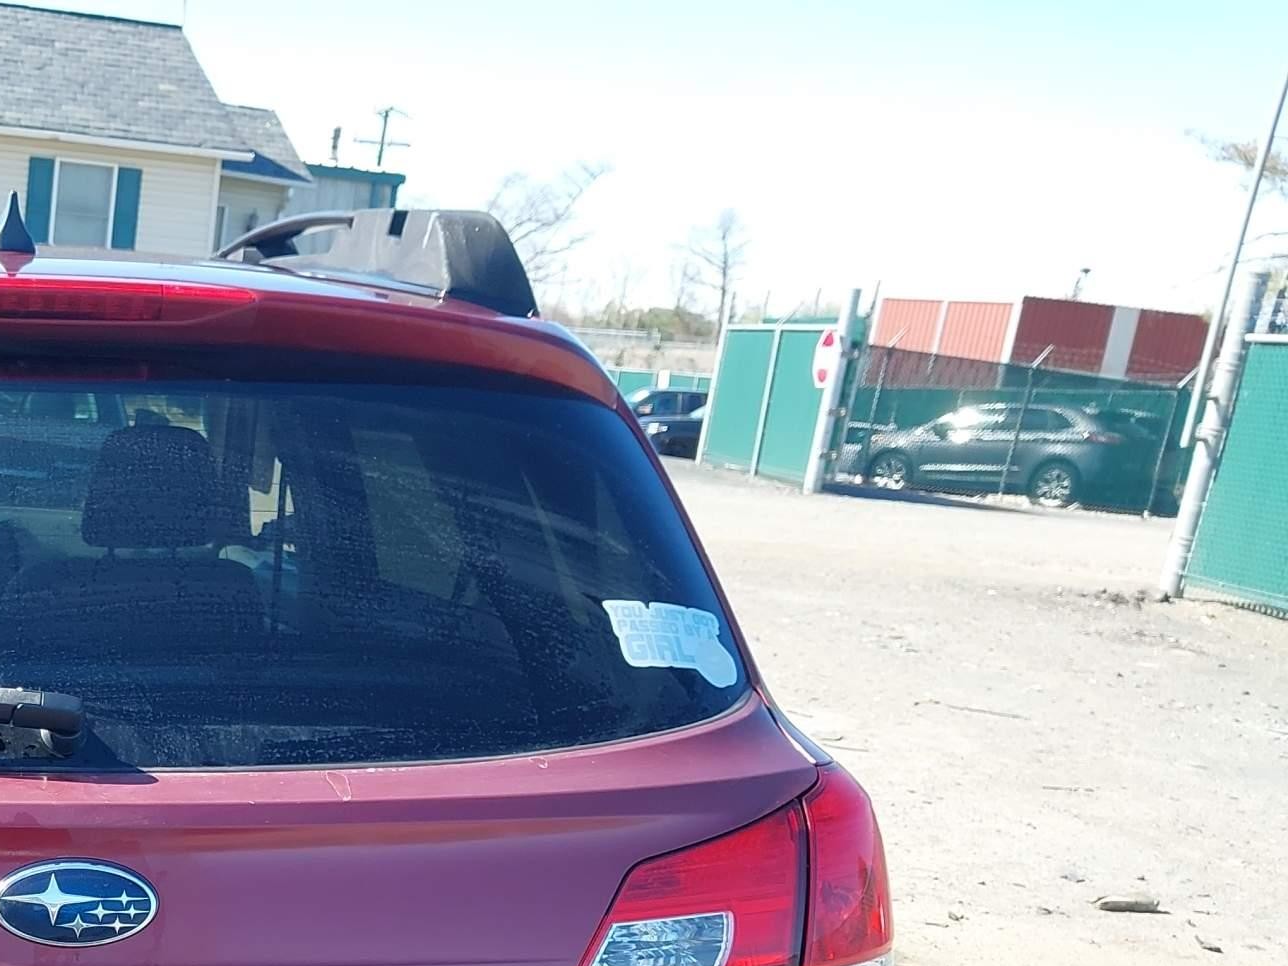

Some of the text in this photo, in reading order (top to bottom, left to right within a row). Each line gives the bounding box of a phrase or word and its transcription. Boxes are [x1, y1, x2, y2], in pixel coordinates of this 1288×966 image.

[612, 605, 643, 618] YOU
[649, 606, 686, 625] JUST
[615, 618, 680, 634] PASSED
[625, 633, 697, 663] GIRL
